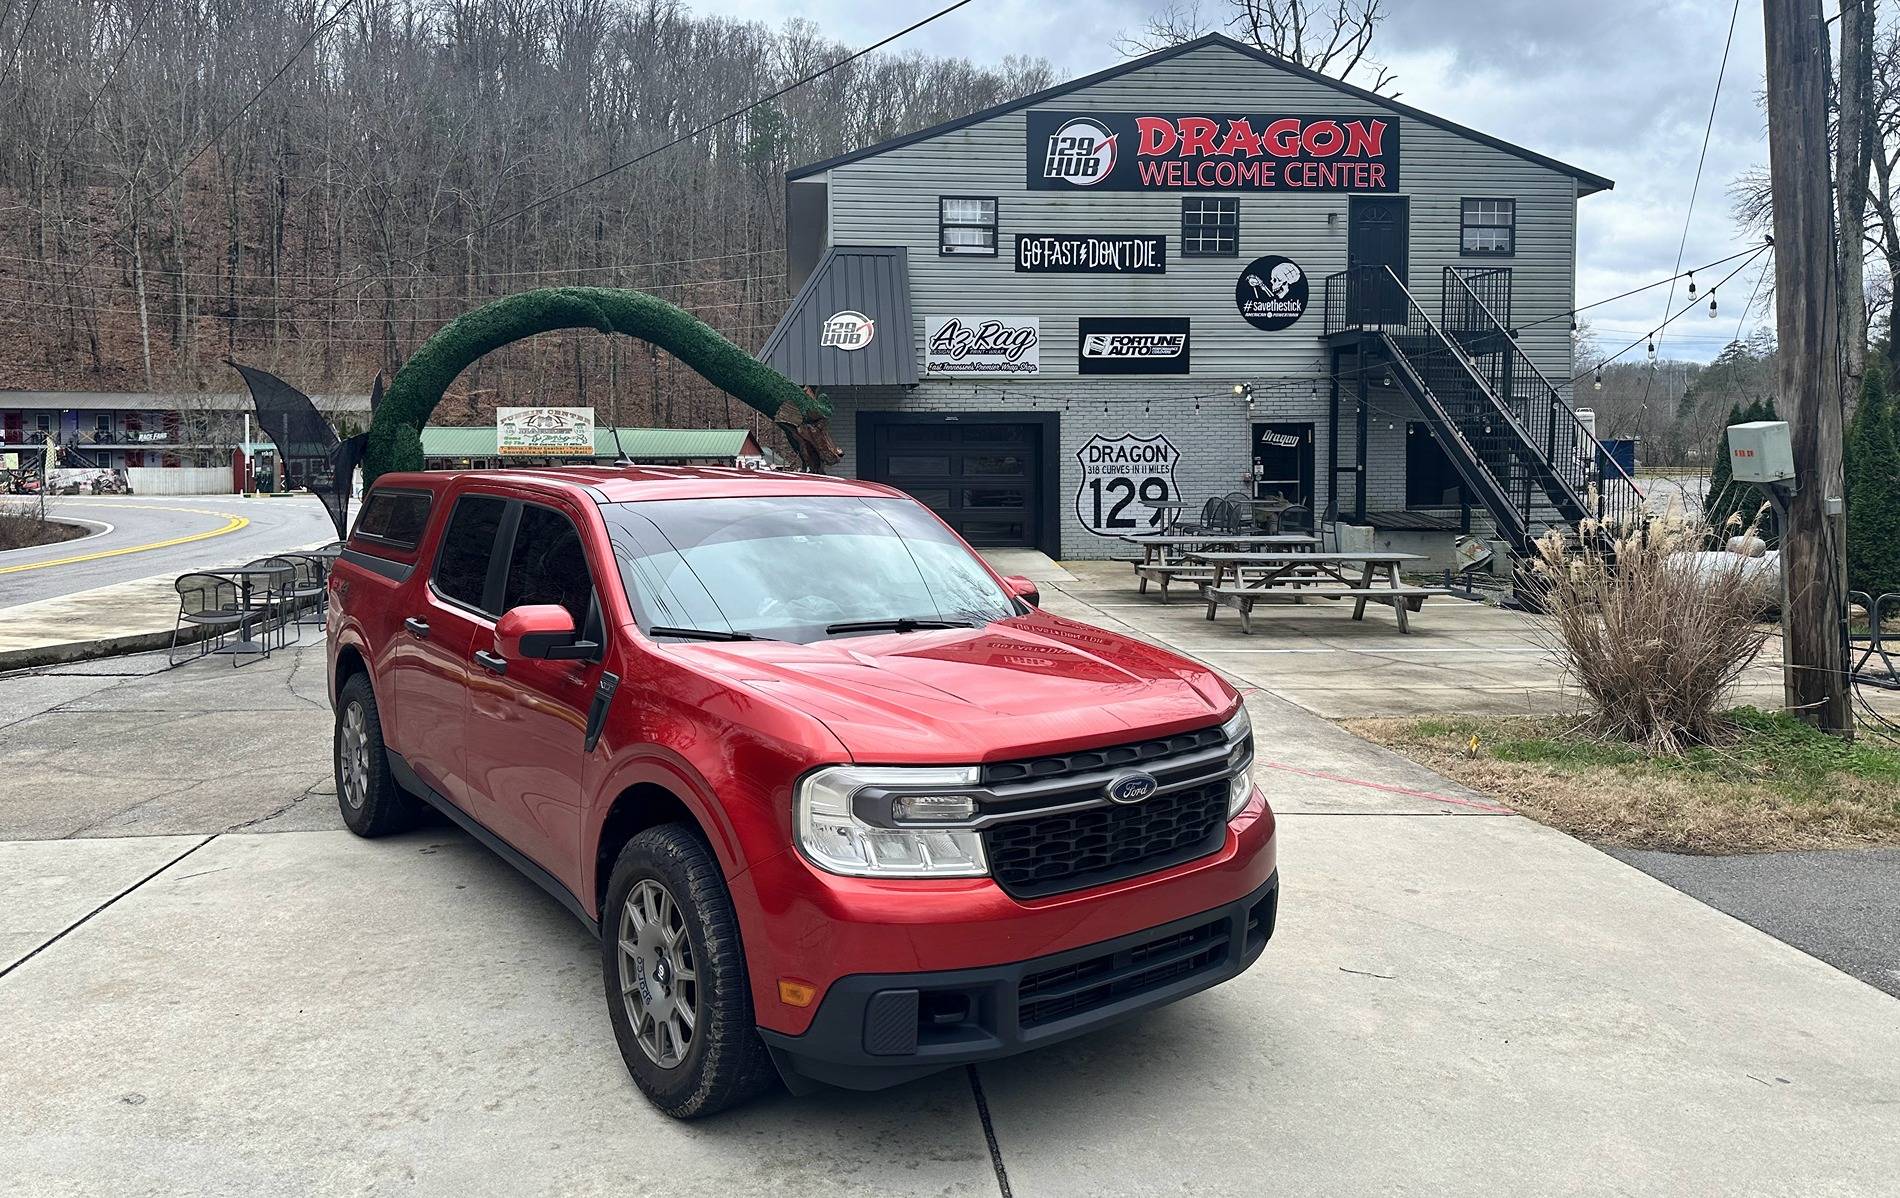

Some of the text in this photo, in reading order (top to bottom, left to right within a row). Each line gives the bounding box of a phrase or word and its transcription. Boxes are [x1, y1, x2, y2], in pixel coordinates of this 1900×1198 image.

[1049, 135, 1095, 156] 129
[1135, 116, 1388, 158] DRAGON
[1044, 157, 1101, 178] HUB
[1138, 161, 1386, 187] WELCOME CENTER
[1243, 299, 1302, 312] #savethestick
[824, 322, 857, 333] 129
[822, 333, 862, 344] HUB
[1110, 336, 1183, 346] FORTUNE
[1108, 346, 1151, 355] AUTO
[1261, 430, 1300, 447] Dragon
[1089, 445, 1168, 463] DRAGON
[1088, 465, 1100, 474] 318
[1102, 465, 1130, 474] CURVES
[1132, 465, 1140, 474] IN
[1148, 465, 1170, 474] MILES
[1089, 477, 1168, 528] 129
[1122, 781, 1148, 798] Ford
